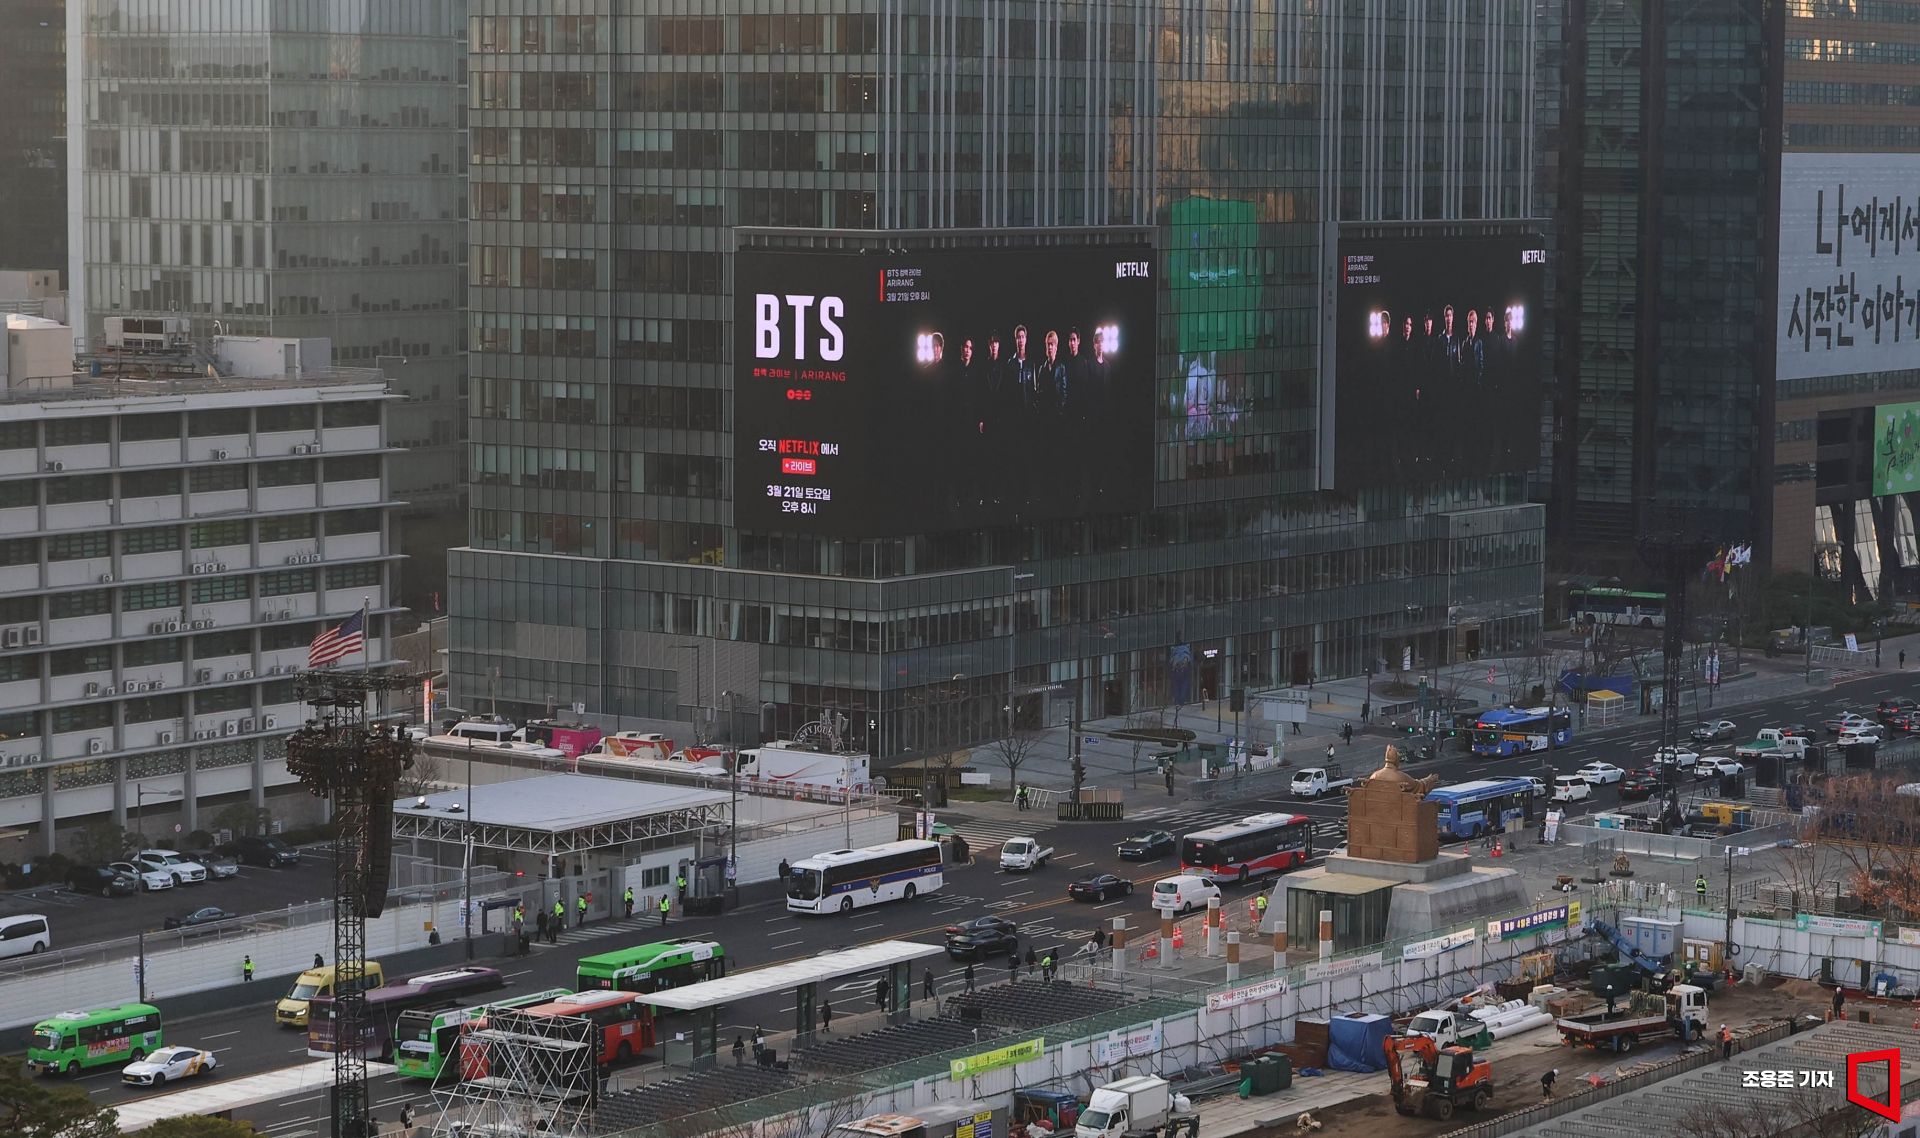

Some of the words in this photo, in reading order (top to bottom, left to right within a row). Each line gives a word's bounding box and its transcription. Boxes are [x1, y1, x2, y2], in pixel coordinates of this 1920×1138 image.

[1816, 184, 1920, 267] 나에게서
[886, 269, 900, 278] BTS
[1116, 261, 1149, 279] NETFLIX
[886, 279, 914, 287] ARIRANG
[1788, 272, 1860, 353] 시작한
[755, 293, 844, 361] BTS
[801, 370, 846, 382] ARIRANG
[759, 439, 777, 452] 오직
[778, 439, 820, 456] NETFLIX
[820, 443, 839, 456] 에서
[790, 461, 813, 472] 라이브
[766, 484, 782, 498] 3월
[783, 485, 804, 499] 21일
[805, 487, 831, 501] 토요일
[781, 500, 799, 513] 오후
[800, 502, 817, 515] 8시
